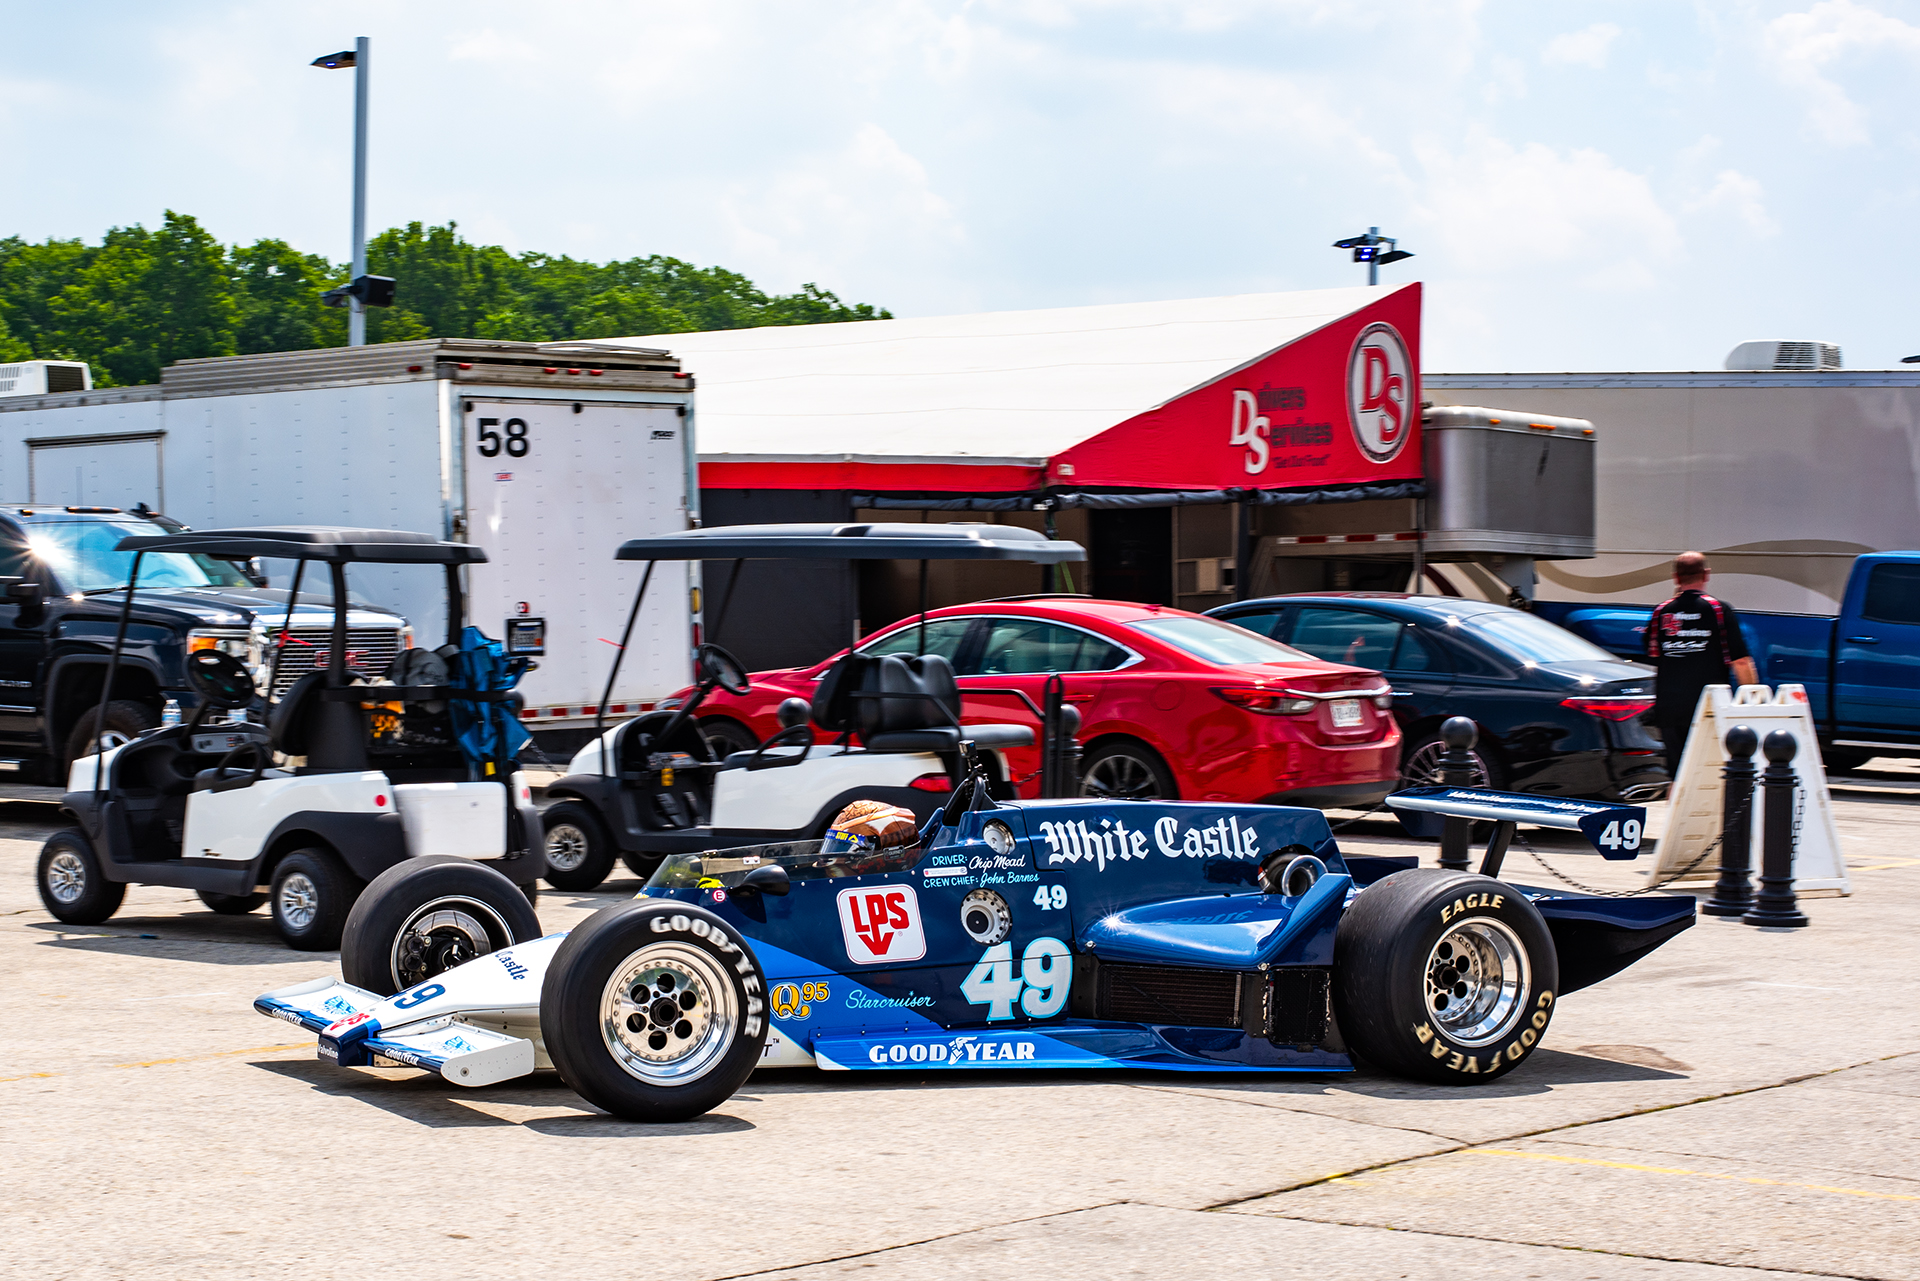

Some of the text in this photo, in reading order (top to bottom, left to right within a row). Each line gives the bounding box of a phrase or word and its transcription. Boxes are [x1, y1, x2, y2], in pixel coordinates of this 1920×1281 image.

[477, 418, 529, 458] 58
[1039, 816, 1261, 872] White Castle
[1599, 819, 1642, 851] 49
[932, 854, 968, 867] DRIVER:
[968, 856, 993, 873] Chip
[993, 855, 1026, 870] Mead
[923, 871, 1041, 888] CREW CHIEF: John Barnes
[1032, 885, 1068, 911] 49
[1440, 893, 1505, 924] EAGLE
[848, 891, 911, 952] LPS
[959, 936, 1074, 1021] 49
[845, 988, 937, 1009] Starcruiser
